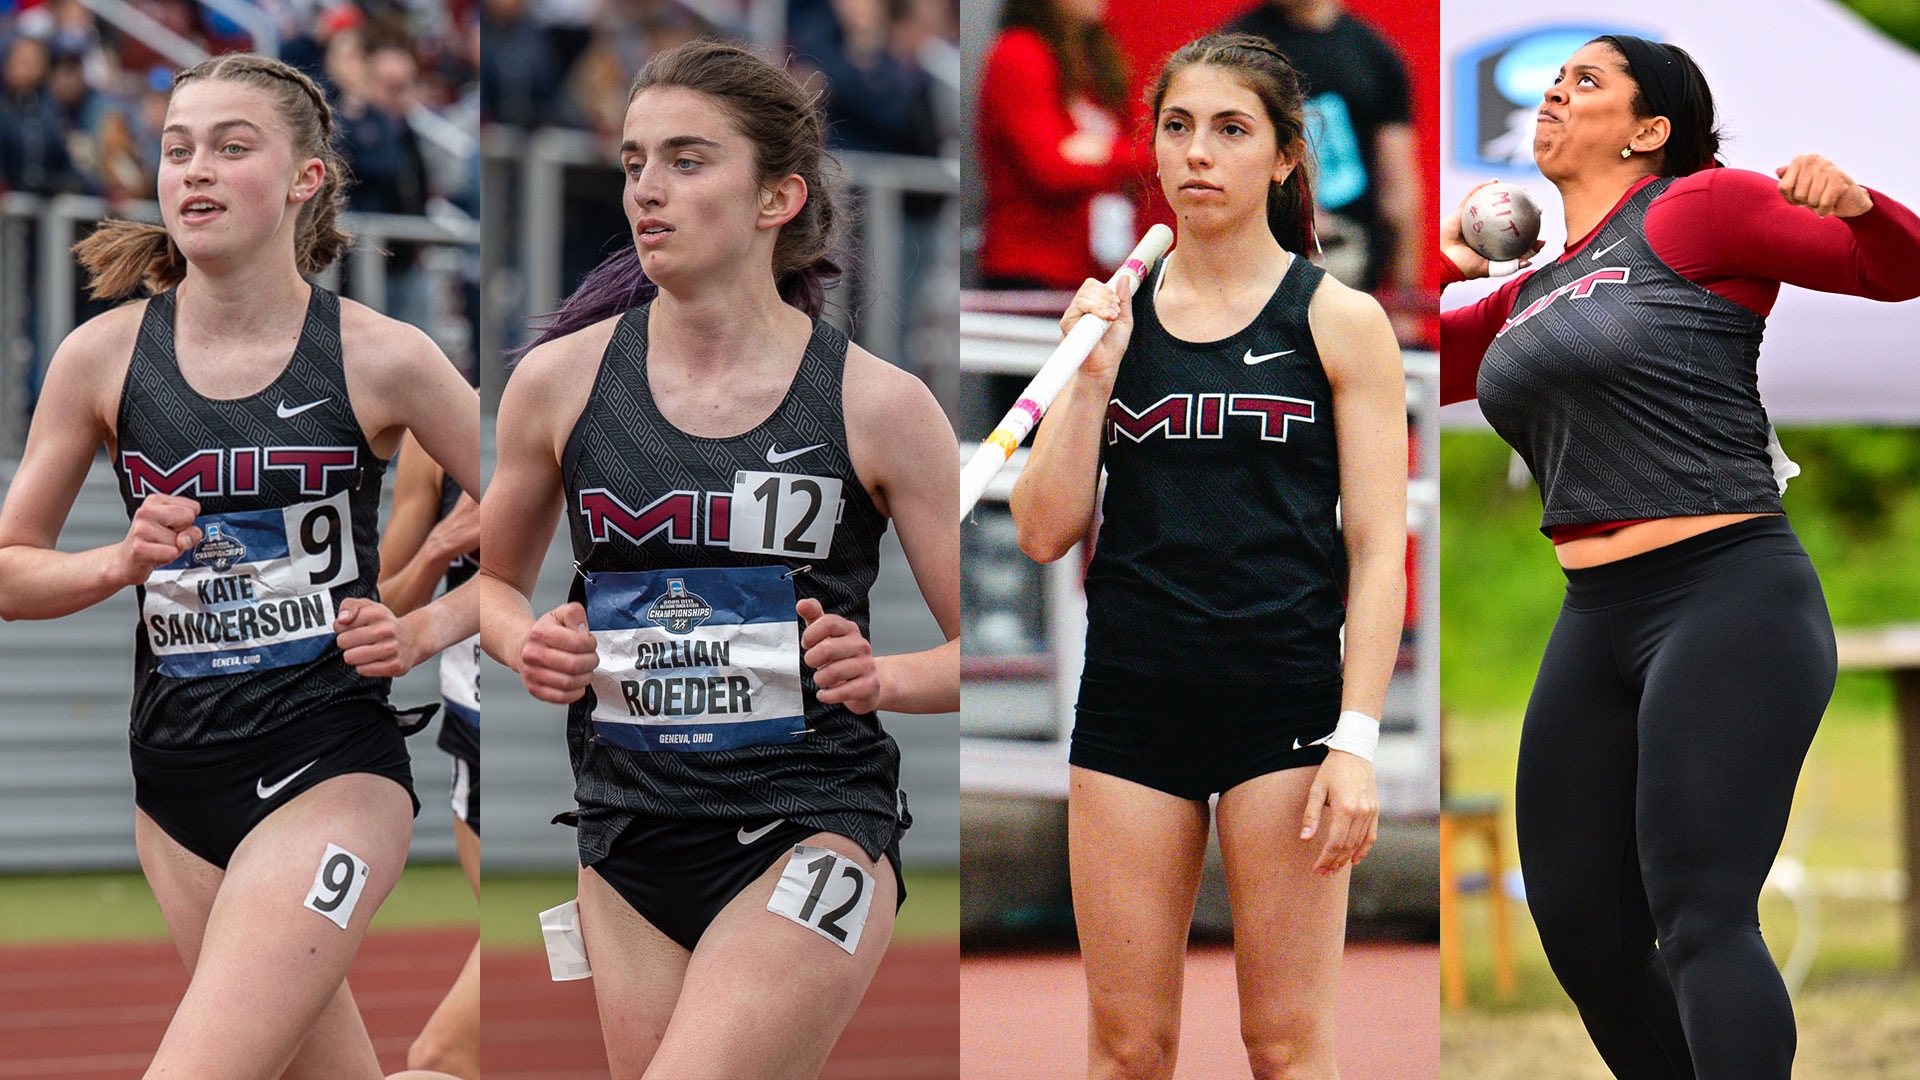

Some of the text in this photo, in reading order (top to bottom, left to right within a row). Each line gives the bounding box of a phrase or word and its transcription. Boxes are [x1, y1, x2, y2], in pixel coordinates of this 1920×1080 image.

[1107, 392, 1316, 446] MIT
[122, 446, 358, 499] MIT
[579, 487, 735, 546] MI
[753, 476, 823, 554] 12
[300, 504, 342, 586] 9
[197, 575, 253, 606] KATE
[649, 607, 710, 618] CHAMPIONSHIPS
[151, 594, 327, 649] SANDERSON
[212, 654, 261, 669] GENEVA, OHIO
[634, 639, 731, 671] GILLIAN
[620, 675, 753, 717] ROEDER
[659, 733, 714, 744] GENEVA, OHIO
[312, 852, 355, 913] 9
[798, 854, 864, 943] 12
